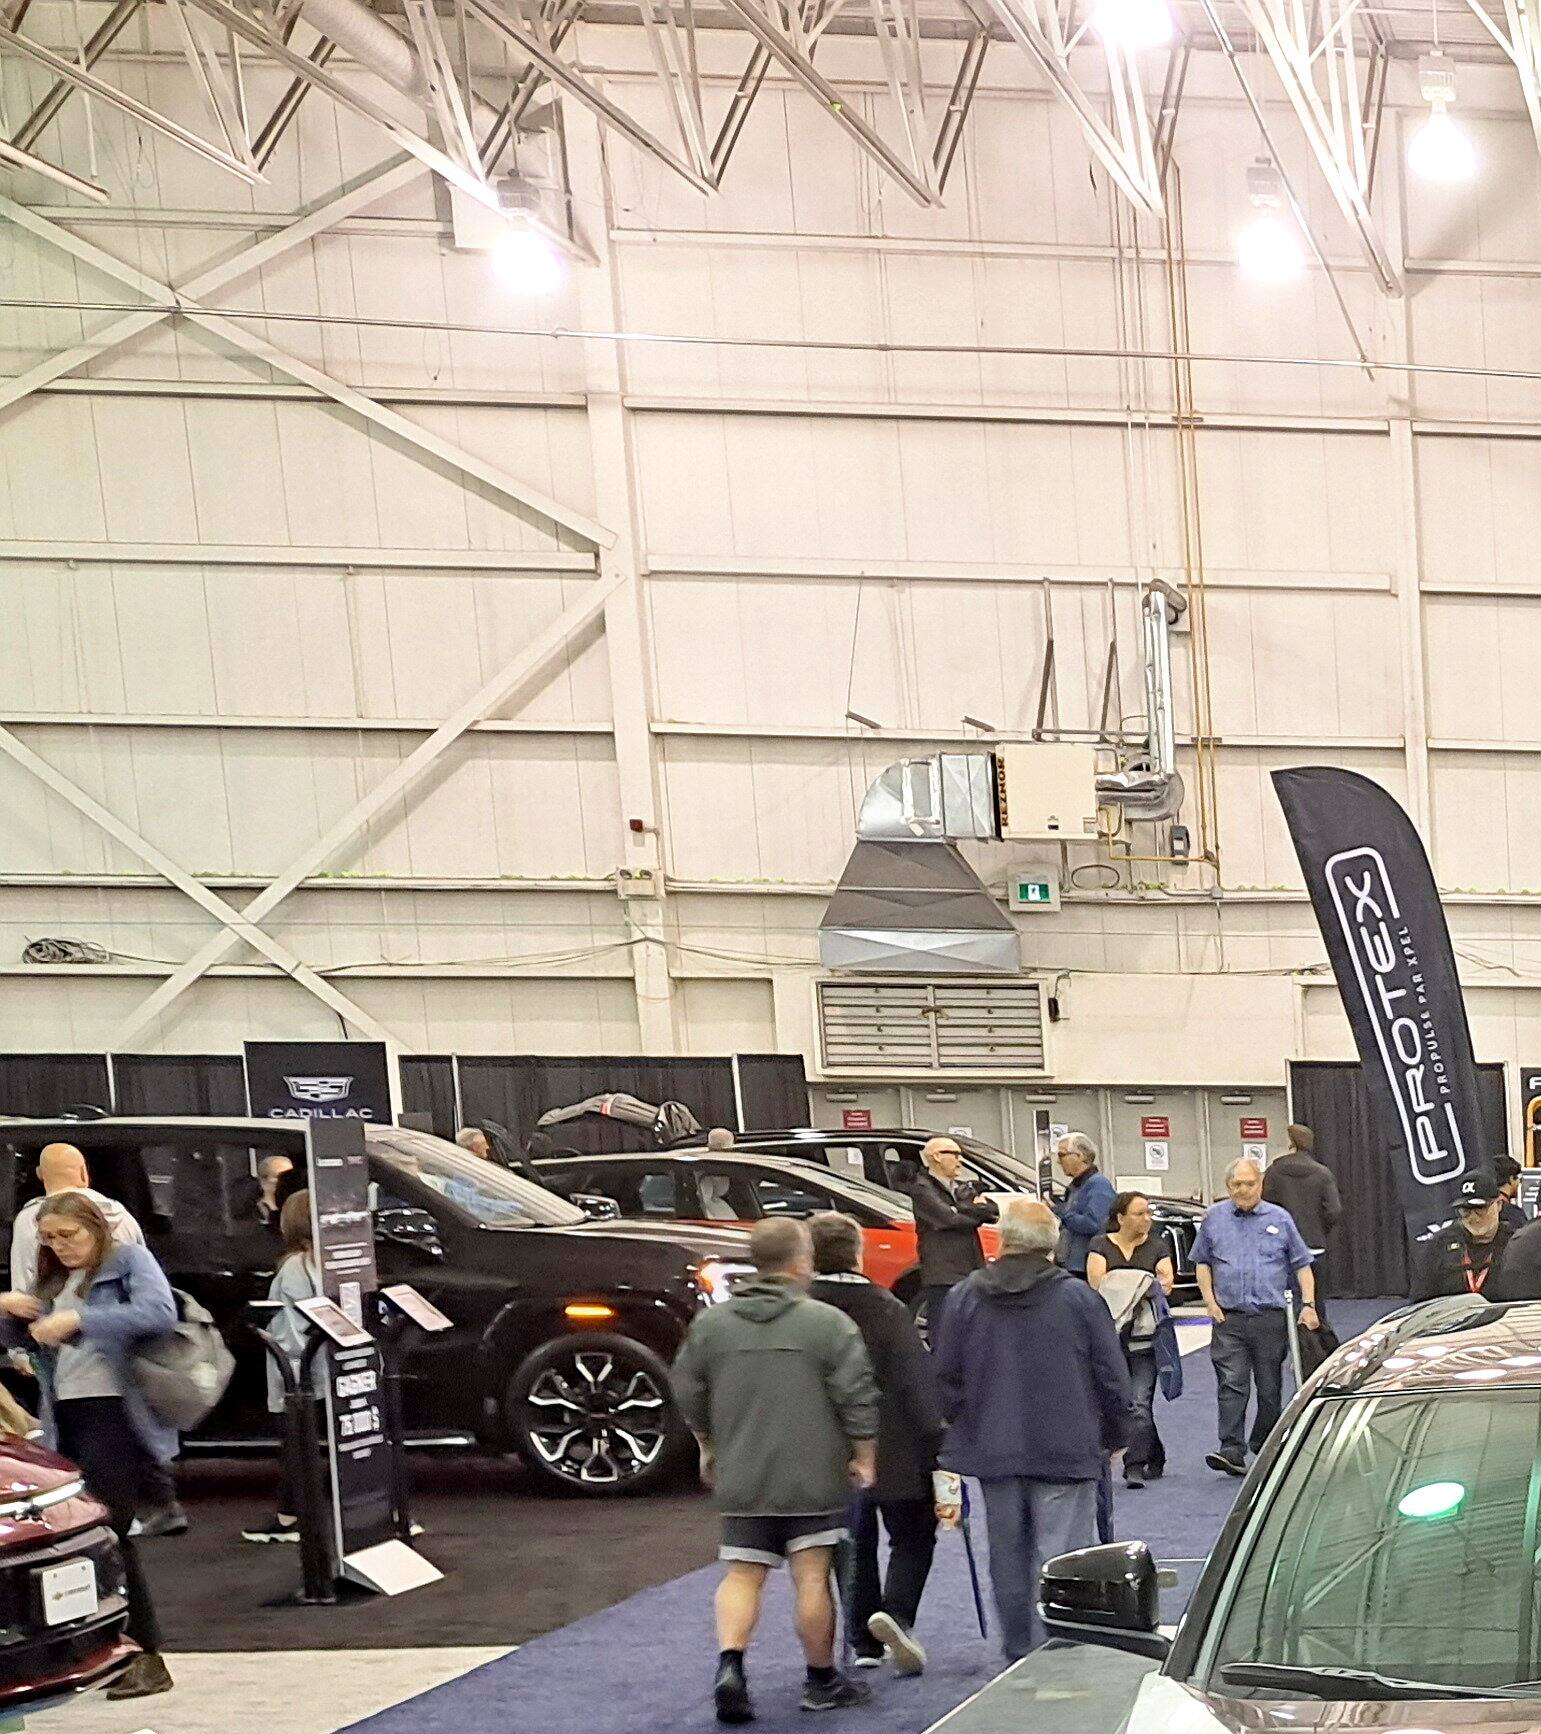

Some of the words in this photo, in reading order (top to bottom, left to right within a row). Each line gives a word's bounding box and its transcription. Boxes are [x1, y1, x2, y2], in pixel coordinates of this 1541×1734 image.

[1398, 925, 1421, 967] XPEL
[1411, 972, 1428, 1006] PAR
[1344, 870, 1448, 1161] PROTEX
[1419, 1011, 1451, 1095] PROPULSE
[270, 1107, 373, 1119] CADILLAC
